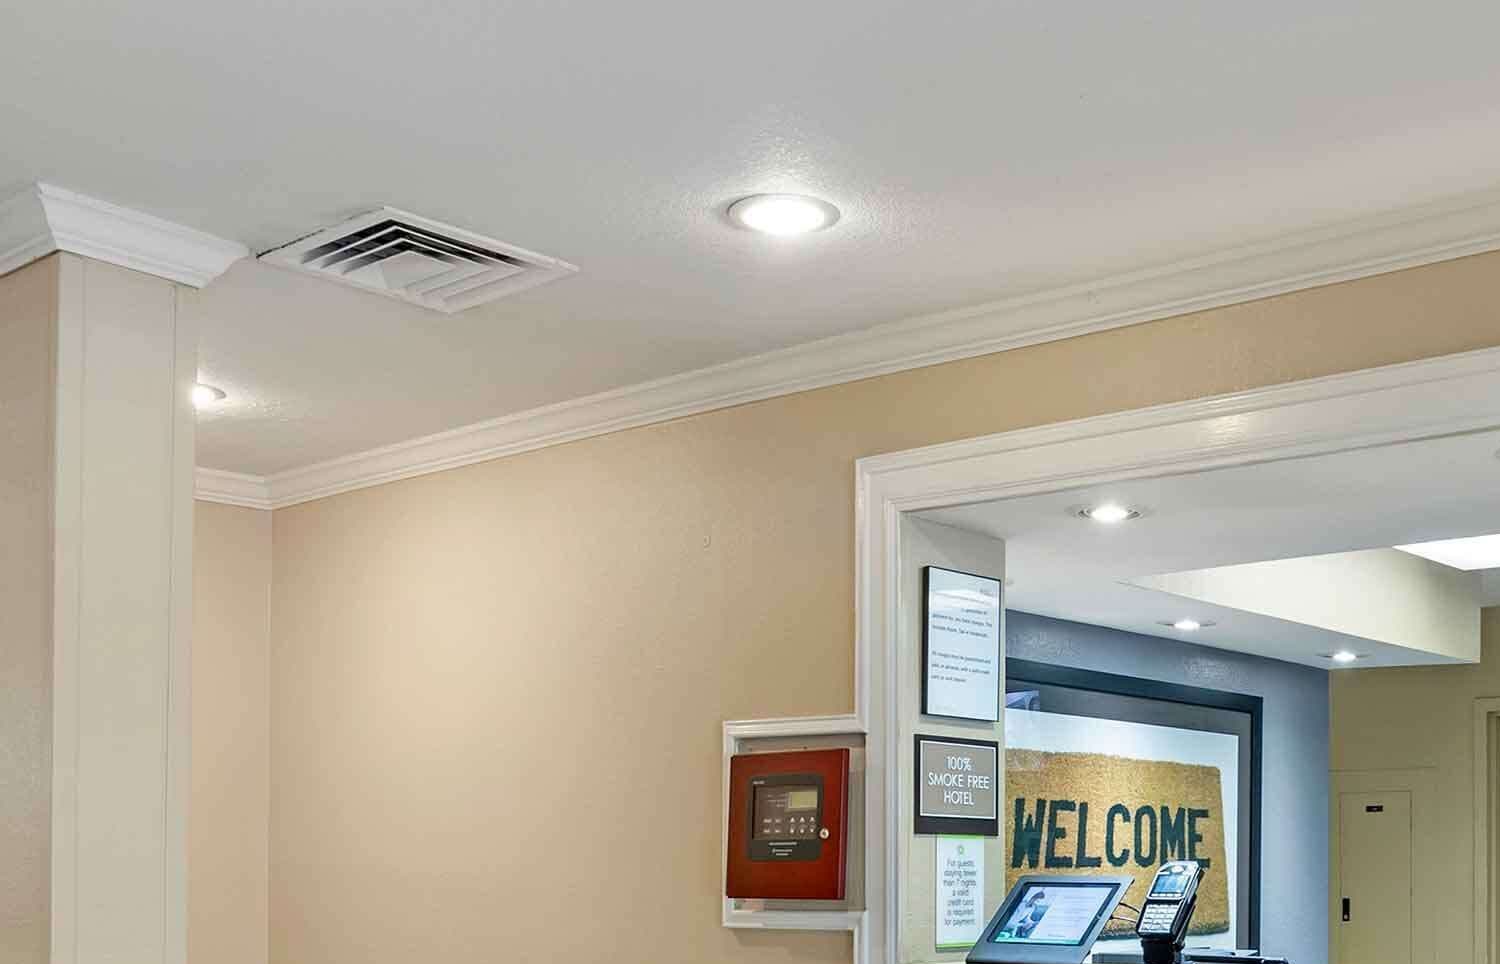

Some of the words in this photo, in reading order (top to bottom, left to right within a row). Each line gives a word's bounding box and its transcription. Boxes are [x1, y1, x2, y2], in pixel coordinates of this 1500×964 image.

[946, 756, 972, 771] 100%
[928, 771, 965, 788] SMOKE
[967, 775, 991, 790] FREE
[943, 790, 975, 806] HOTEL
[1011, 798, 1210, 868] WELCOME
